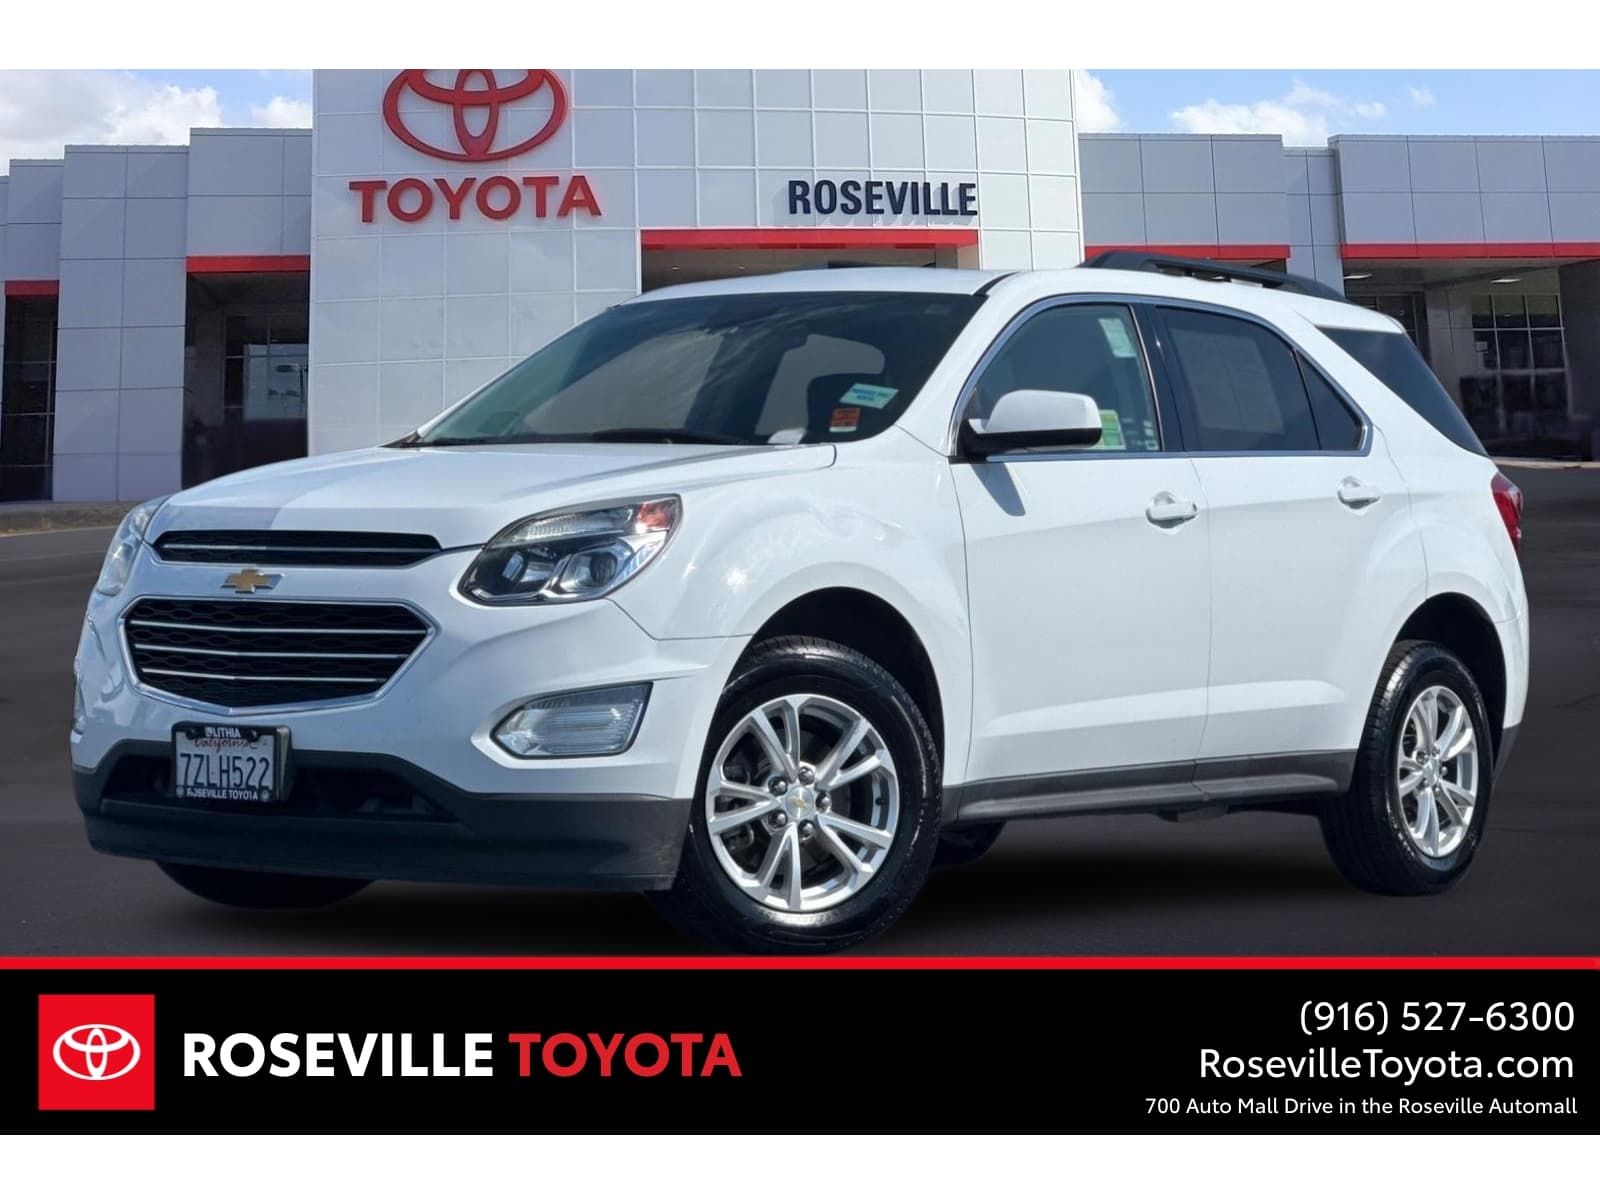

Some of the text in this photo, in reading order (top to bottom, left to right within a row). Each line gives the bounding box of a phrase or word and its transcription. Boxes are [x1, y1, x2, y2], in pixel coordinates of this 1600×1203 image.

[349, 175, 601, 223] TOYOTA
[788, 179, 978, 216] ROSEVILLE
[213, 727, 241, 738] LITHIA
[180, 753, 270, 789] 7ZLH522
[186, 787, 258, 800] ROSEVILLE TOYOTA
